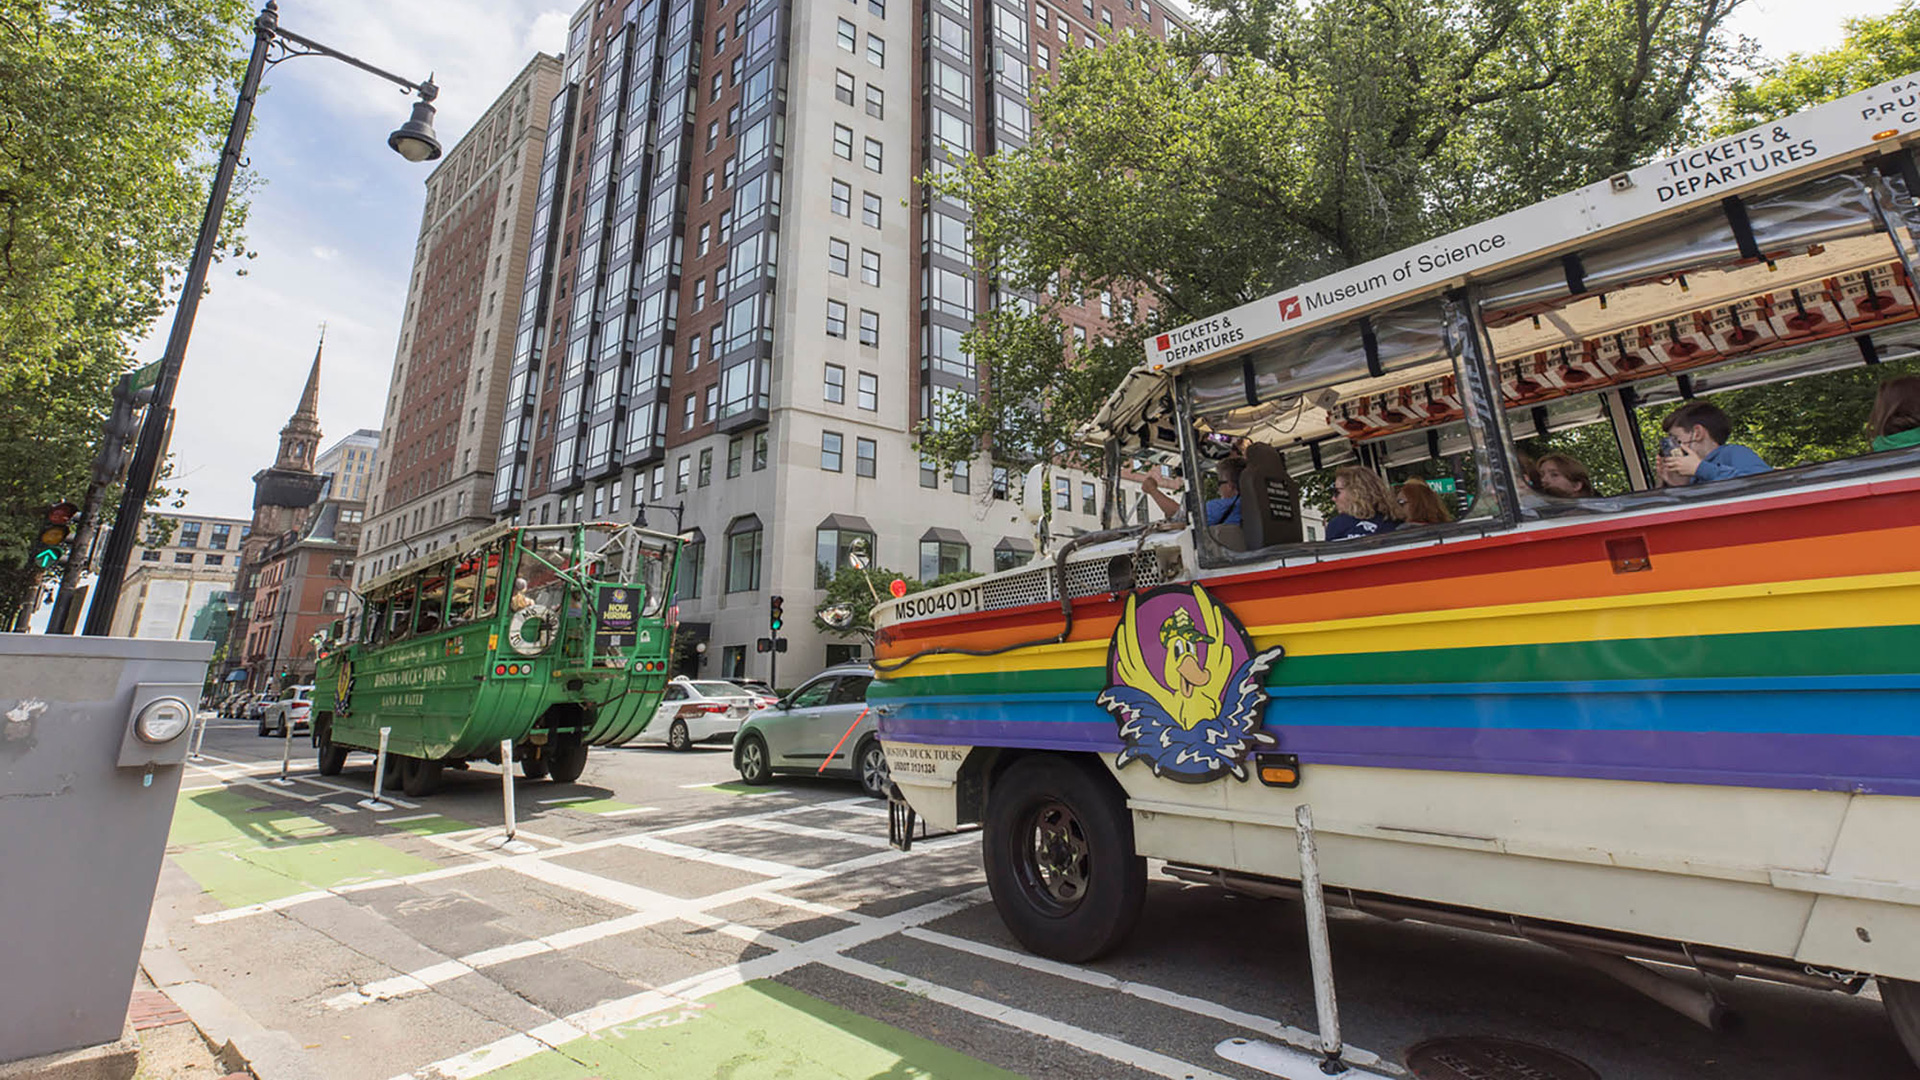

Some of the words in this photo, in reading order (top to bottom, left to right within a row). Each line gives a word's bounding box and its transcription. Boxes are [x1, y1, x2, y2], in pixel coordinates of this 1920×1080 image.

[1862, 93, 1920, 120] PRU
[1666, 134, 1765, 177] TICKETS
[1772, 126, 1791, 142] &
[1657, 139, 1818, 202] DEPARTURES
[1306, 274, 1388, 311] Museum
[1392, 260, 1412, 282] of
[1418, 234, 1507, 274] Science
[1171, 319, 1220, 345] TICKETS
[1222, 316, 1232, 329] &
[1165, 327, 1245, 363] DEPARTURES
[608, 603, 629, 612] NOW
[961, 586, 981, 608] DT
[603, 610, 632, 620] HIRING
[910, 748, 932, 760] DUCK
[934, 749, 963, 761] TOURS
